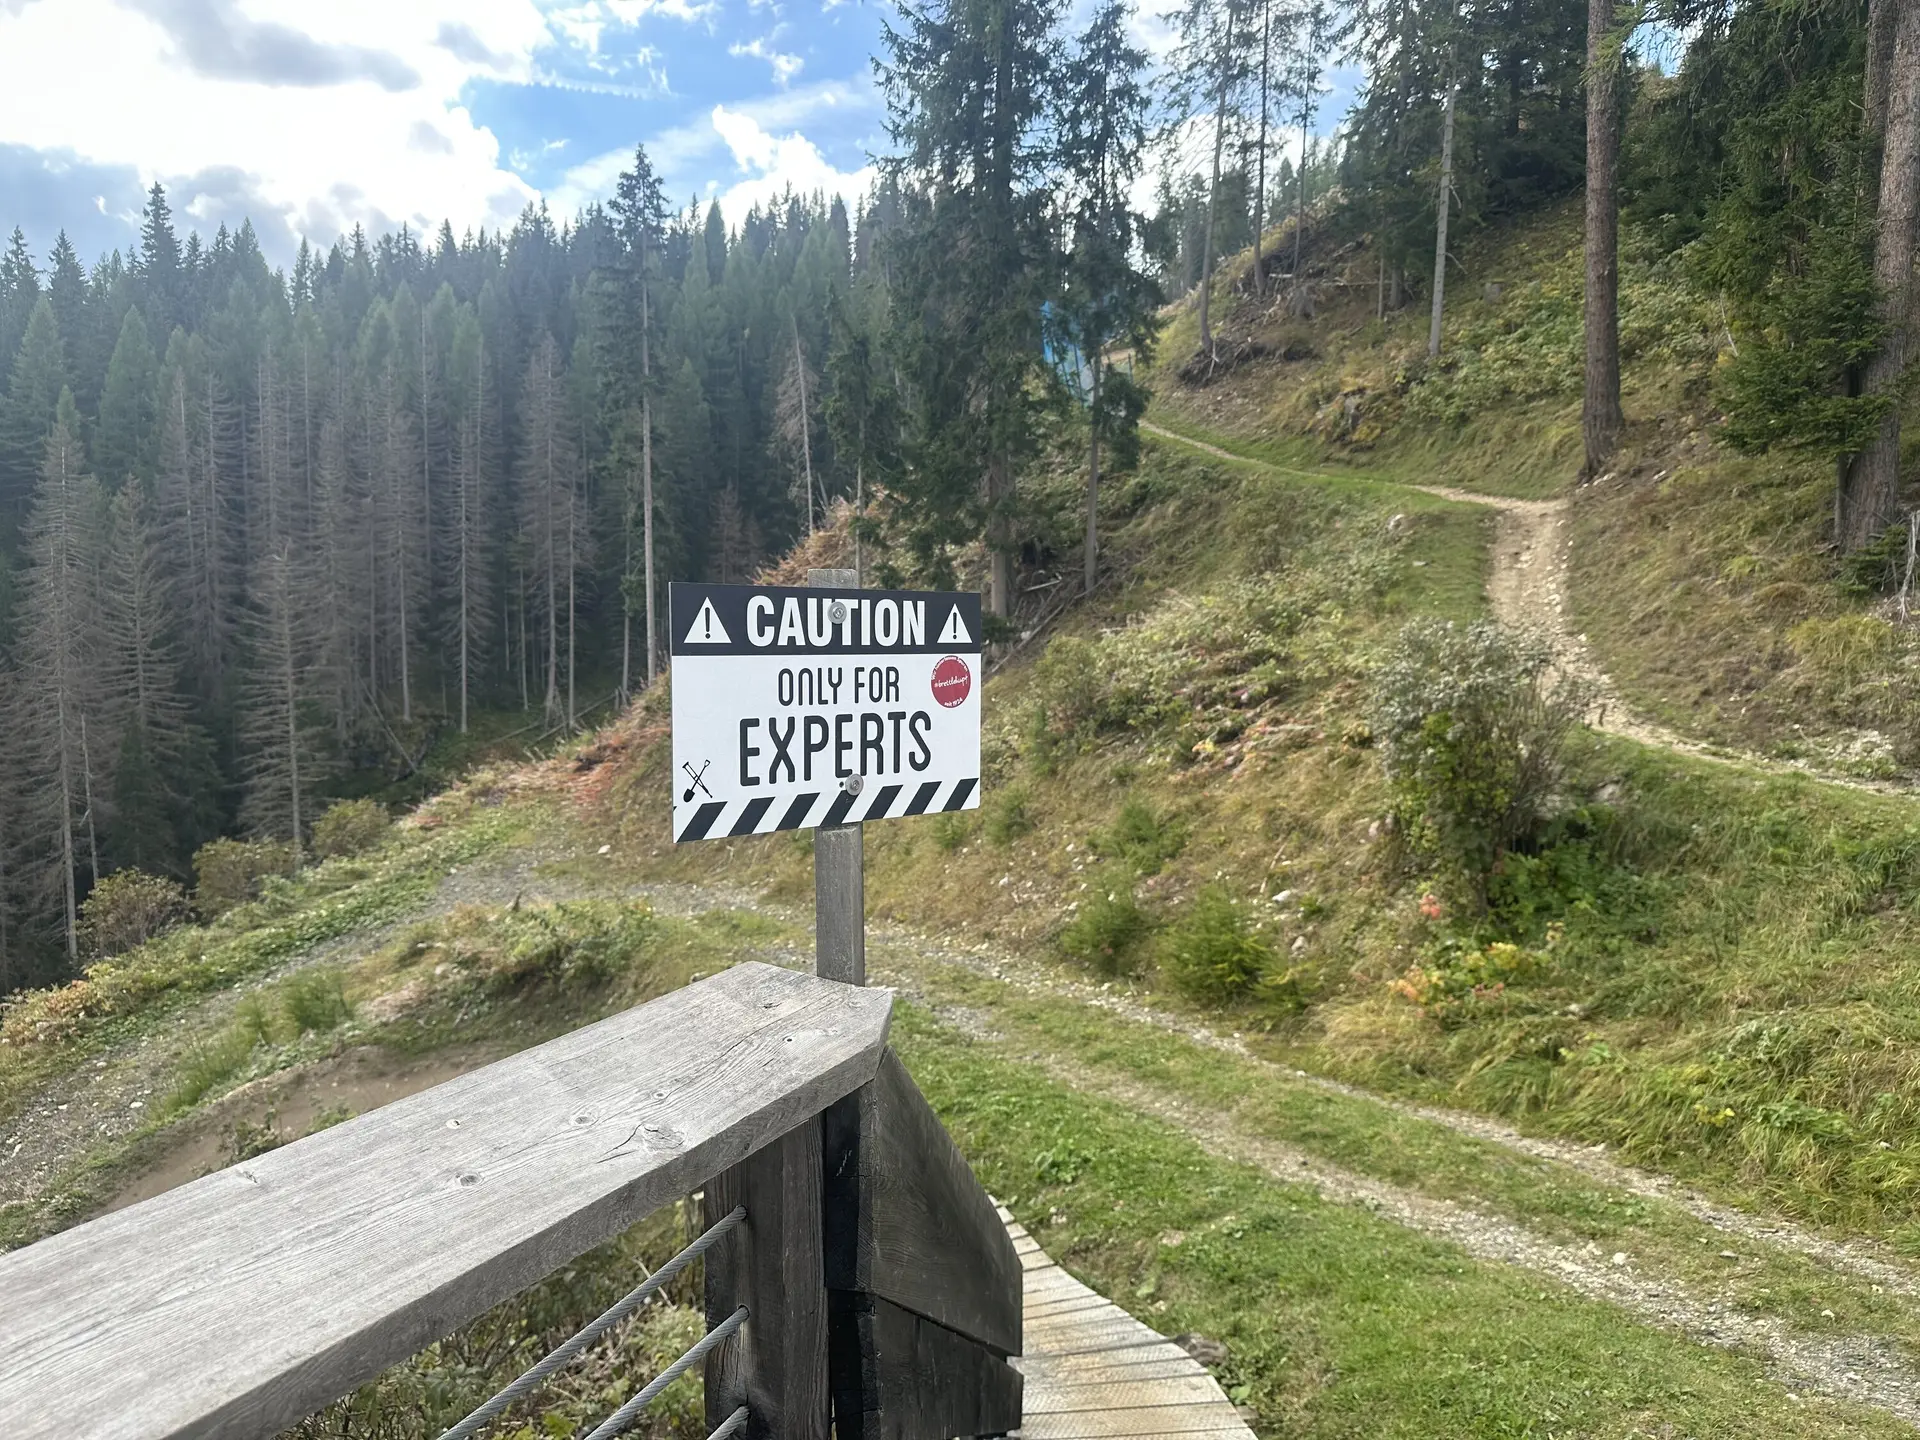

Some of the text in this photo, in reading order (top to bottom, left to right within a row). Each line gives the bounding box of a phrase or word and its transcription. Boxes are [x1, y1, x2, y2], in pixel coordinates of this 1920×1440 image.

[746, 595, 926, 647] CAUTION
[778, 666, 899, 706] ONLY FOR
[740, 711, 931, 786] EXPERTS
